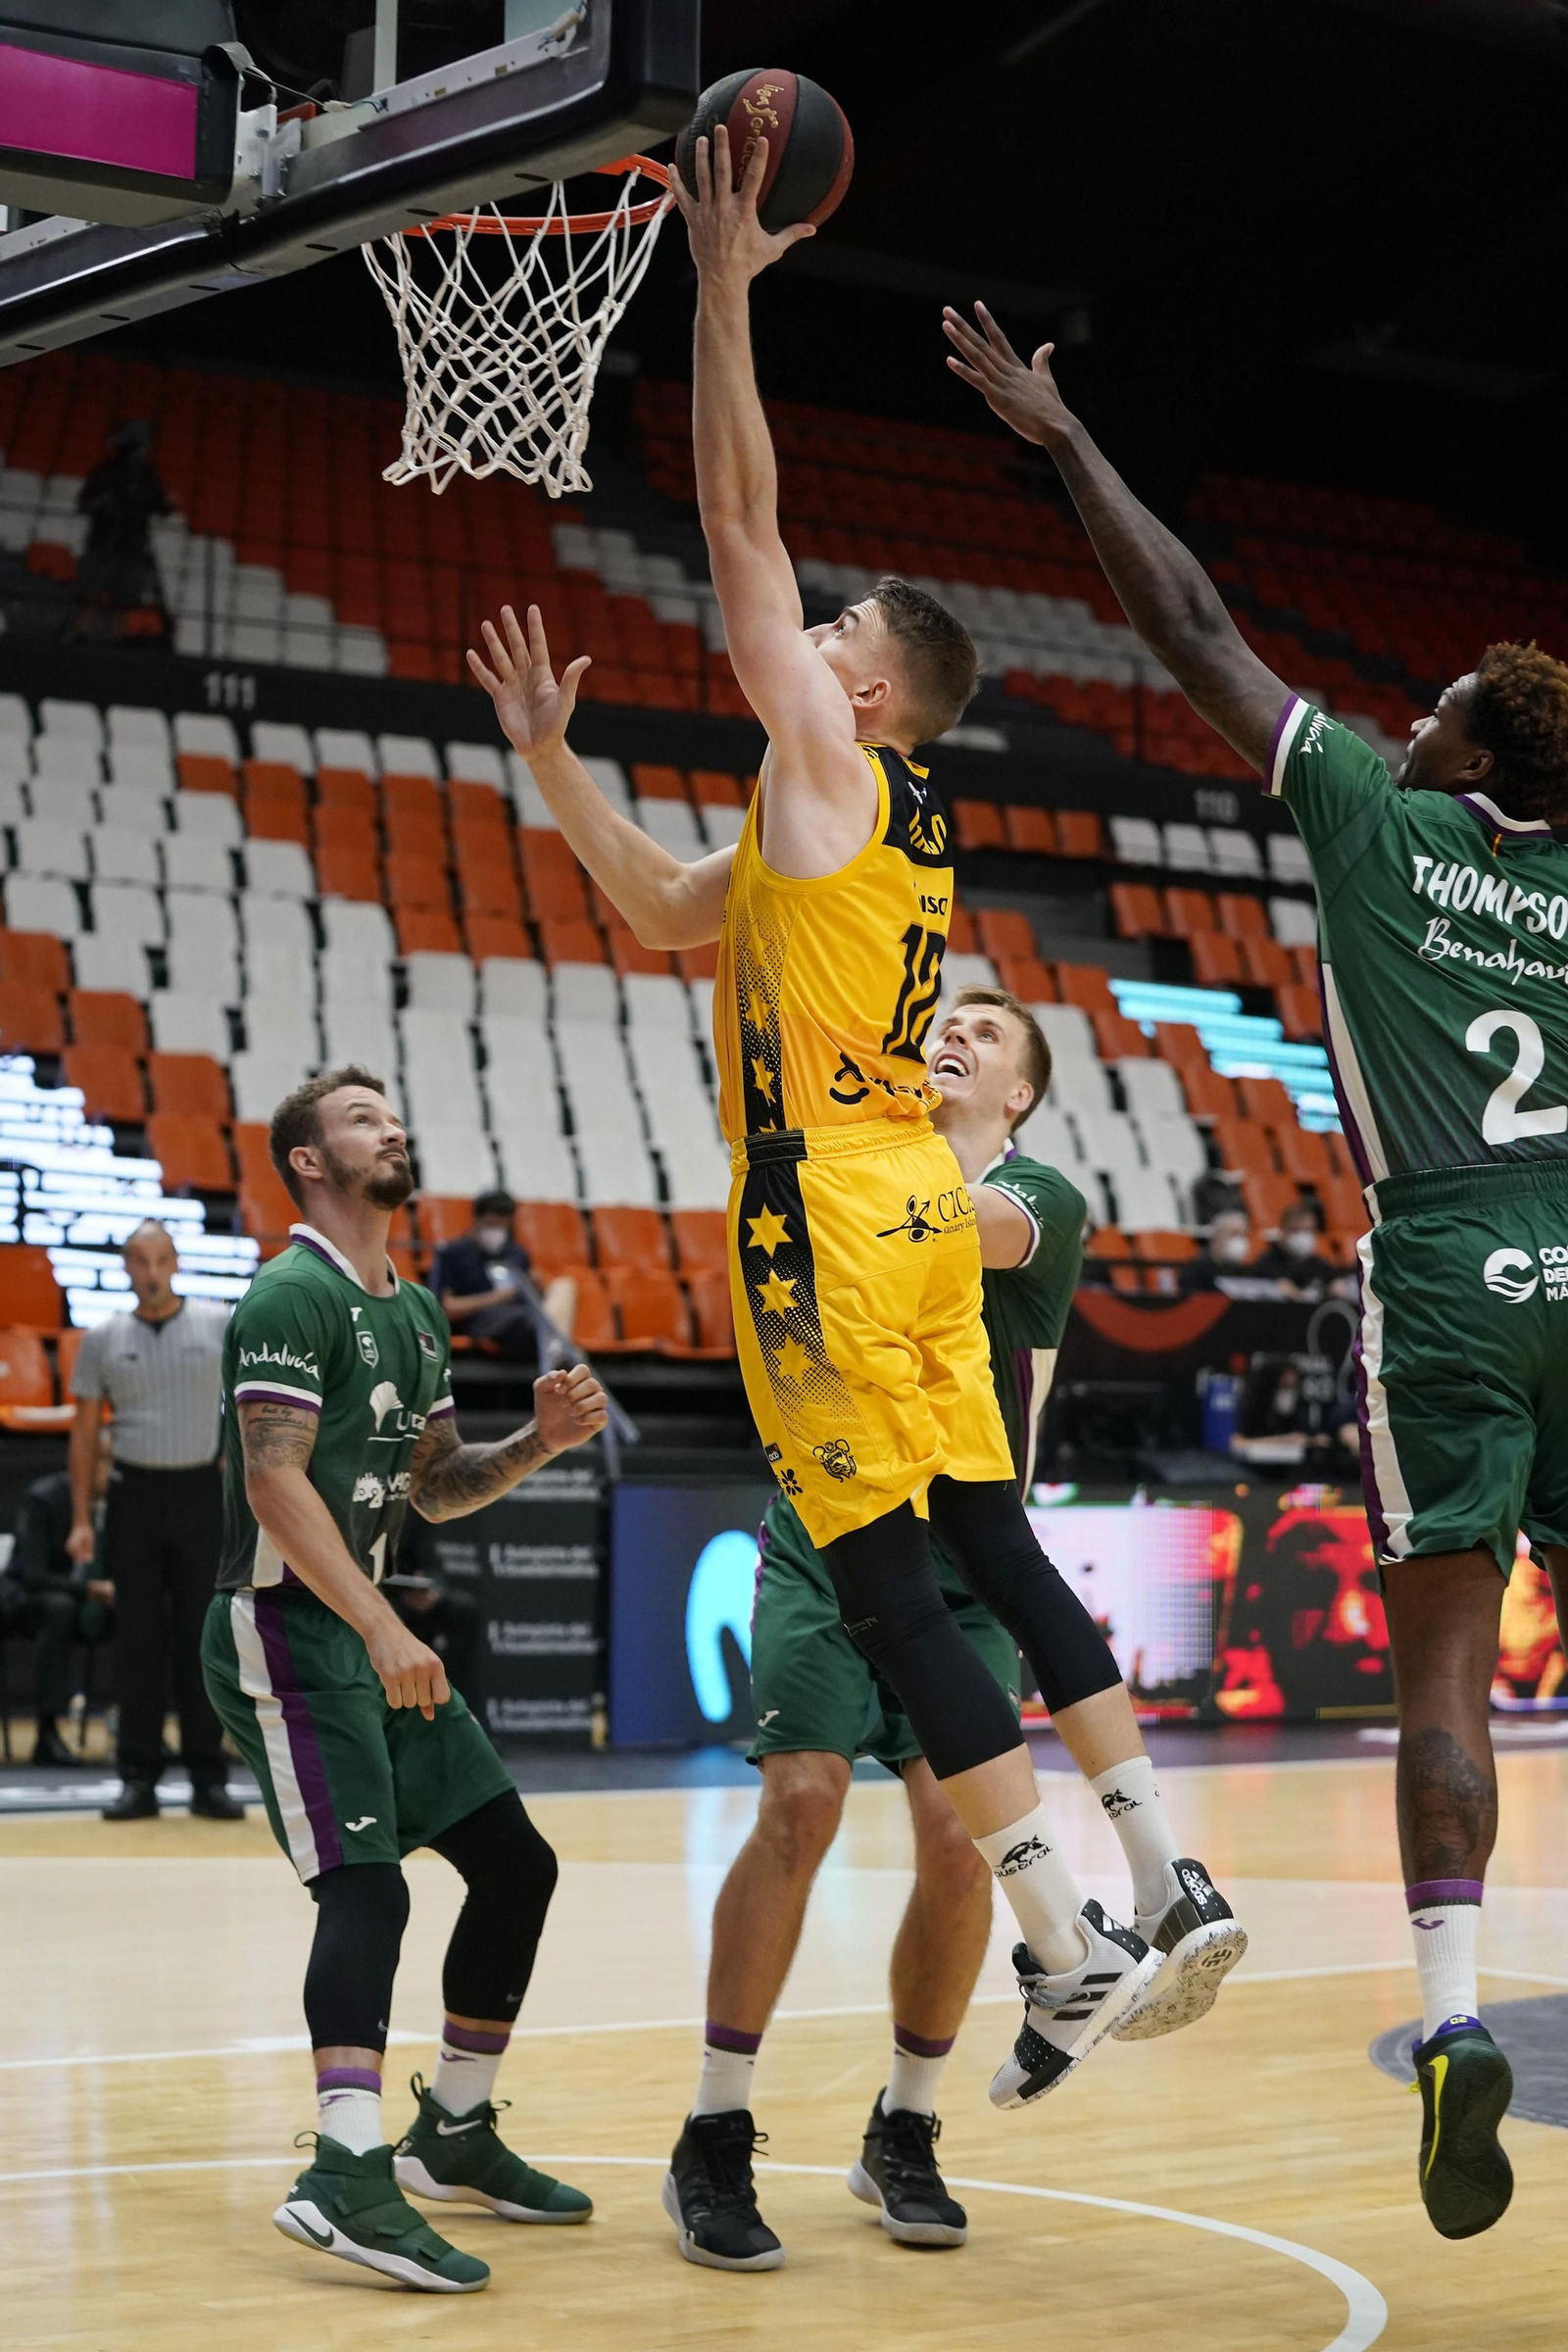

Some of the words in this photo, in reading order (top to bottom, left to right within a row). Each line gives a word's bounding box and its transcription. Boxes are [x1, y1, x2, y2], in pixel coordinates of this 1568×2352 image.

[203, 670, 257, 710] 111
[1465, 1009, 1568, 1147] 2
[1539, 1246, 1568, 1266] CO
[994, 1845, 1054, 1878] austral
[1181, 1868, 1208, 1905] adidas
